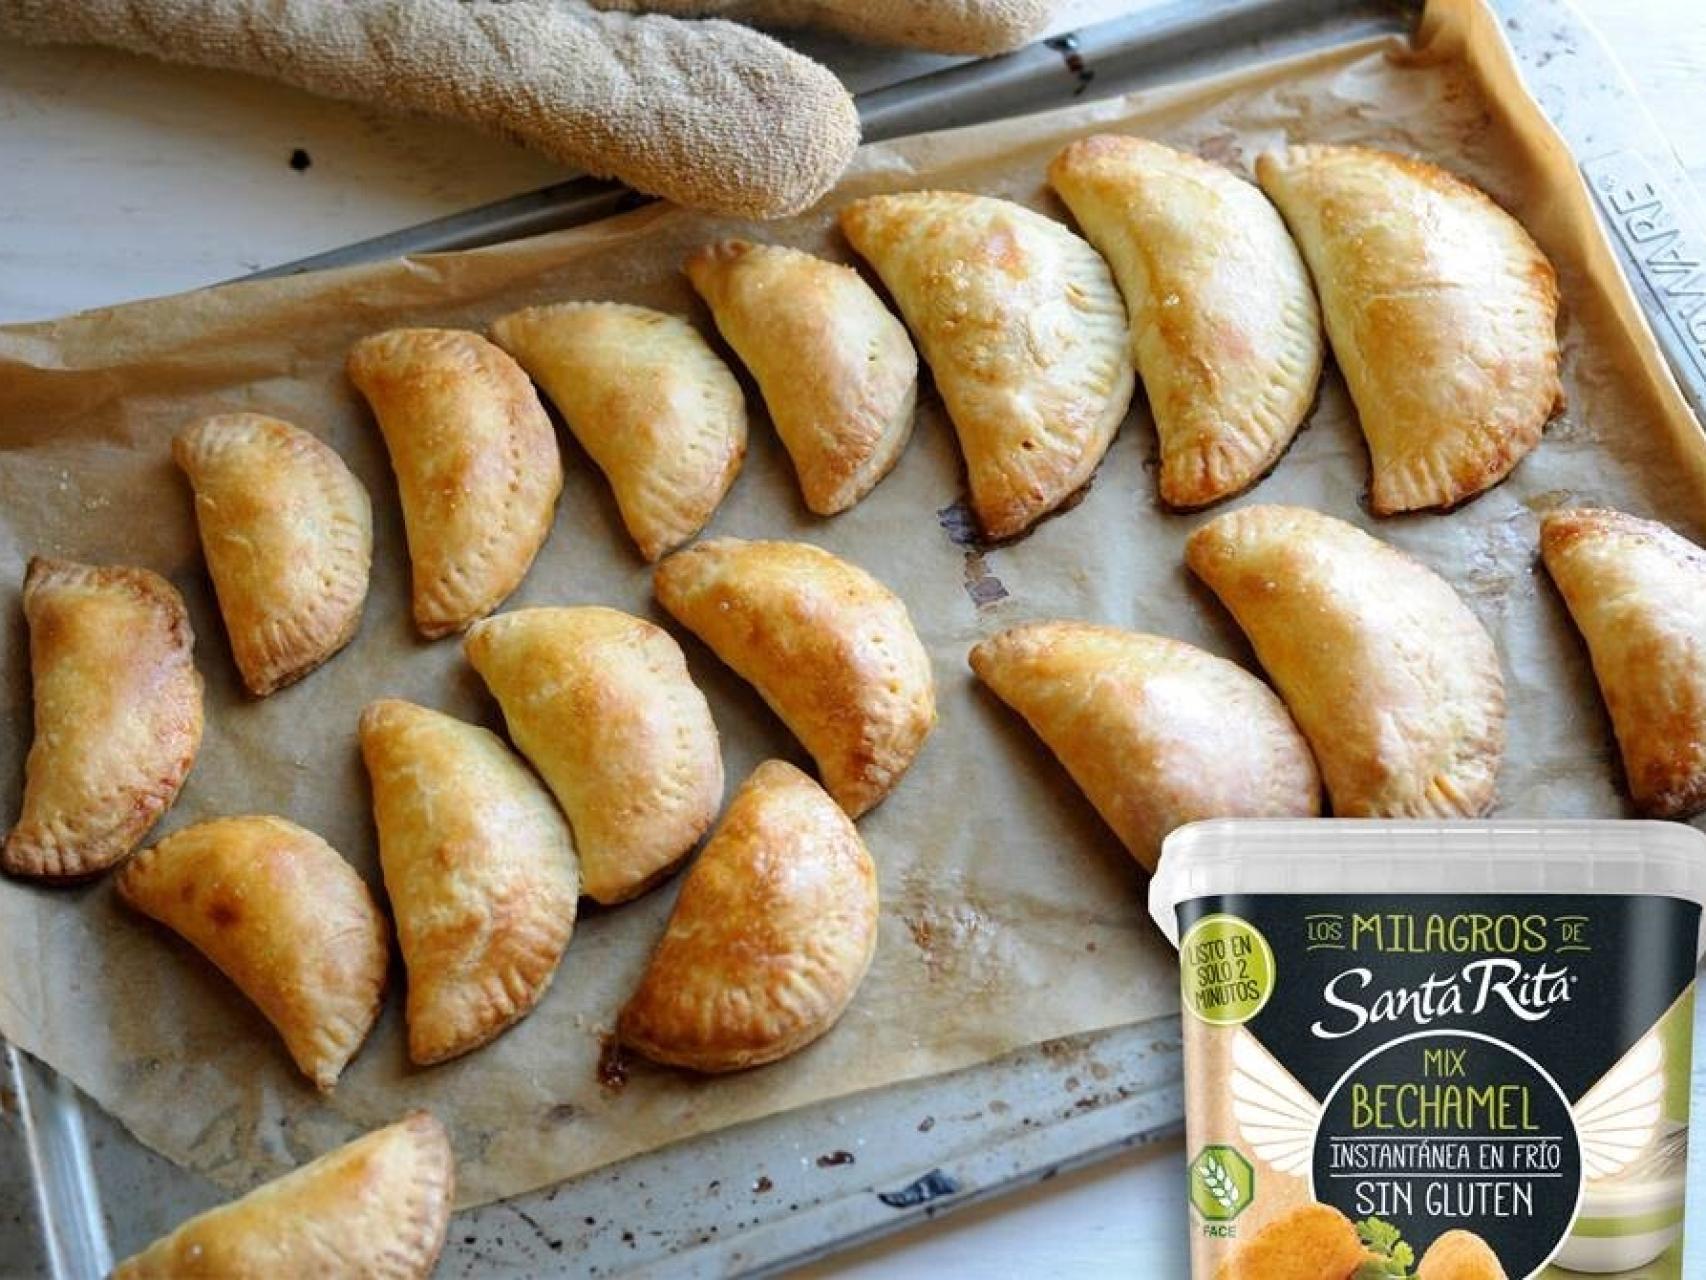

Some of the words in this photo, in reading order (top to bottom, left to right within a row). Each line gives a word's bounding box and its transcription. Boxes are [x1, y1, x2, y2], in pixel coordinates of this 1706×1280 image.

[1306, 921, 1343, 942] LOS
[1351, 913, 1548, 953] MILAGROS
[1561, 921, 1583, 943] DE
[1188, 939, 1226, 966] LISTO
[1231, 935, 1252, 958] EN
[1196, 960, 1233, 987] SOLO
[1236, 958, 1250, 980] 2
[1195, 979, 1261, 1010] MINUTOS
[1310, 967, 1464, 1039] Santa
[1461, 958, 1572, 1021] Rita
[1423, 1048, 1468, 1078] MIX
[1351, 1082, 1541, 1131] BECHAMEL
[1329, 1137, 1471, 1170] INSTANTÁNEA
[1479, 1143, 1505, 1170] EN
[1512, 1139, 1561, 1171] FRÍO
[1354, 1180, 1414, 1217] SIN
[1425, 1180, 1534, 1218] GLUTEN
[1202, 1224, 1237, 1239] FACE
